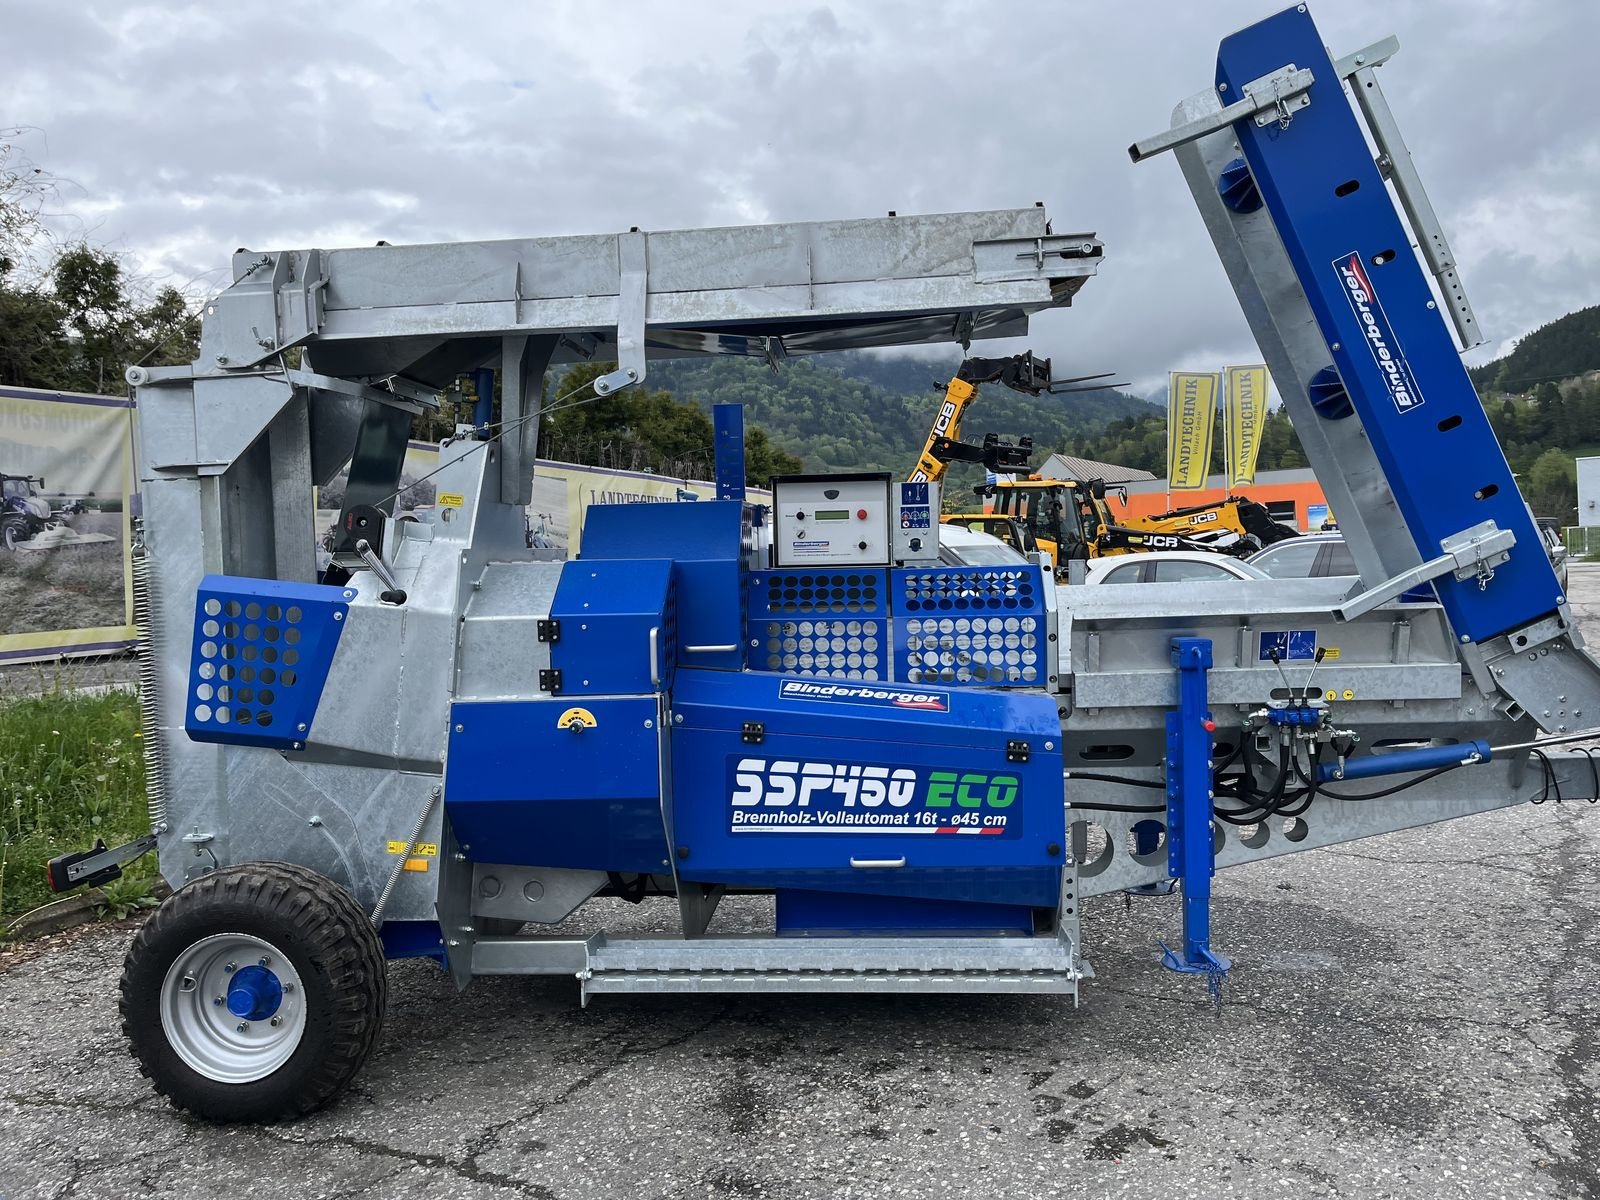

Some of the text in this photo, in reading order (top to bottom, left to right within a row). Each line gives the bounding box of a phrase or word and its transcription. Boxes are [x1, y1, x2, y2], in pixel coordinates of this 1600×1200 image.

[1341, 266, 1413, 406] Binderberger
[933, 402, 956, 438] JCB
[1177, 379, 1197, 484] LANDTECHNIK
[1237, 371, 1254, 477] LANDTECHNIK
[1190, 512, 1217, 525] JCB
[1143, 535, 1178, 548] JCB
[783, 682, 941, 703] Binderberger
[731, 758, 1019, 808] SSP450 ECO
[732, 810, 909, 825] Brennholz-Vollautomat
[914, 811, 938, 825] 16t
[951, 812, 980, 826] ø45
[983, 815, 1007, 826] cm
